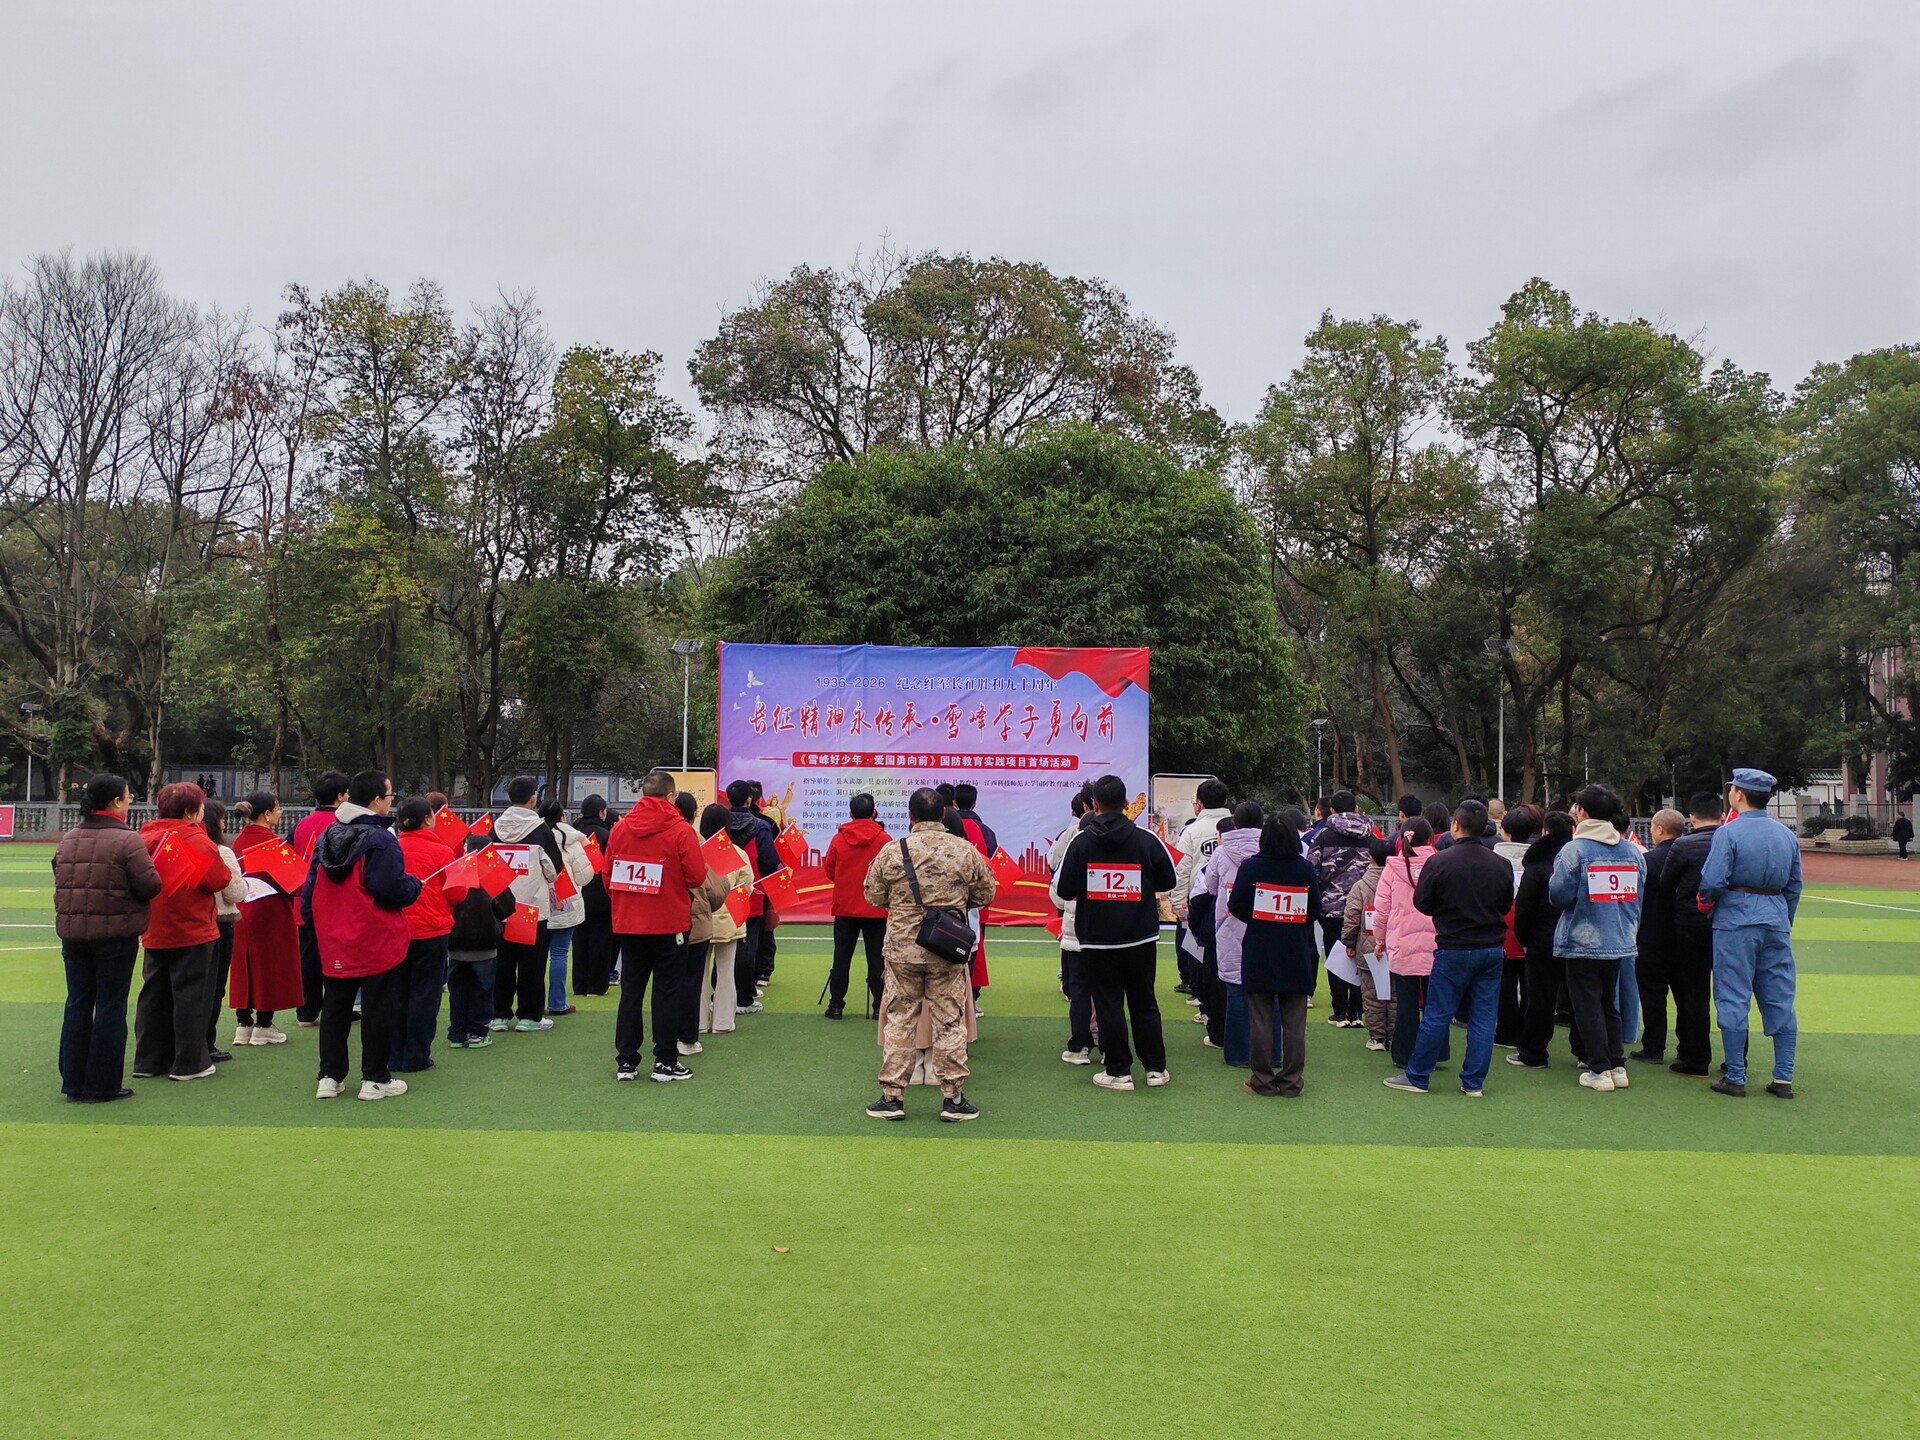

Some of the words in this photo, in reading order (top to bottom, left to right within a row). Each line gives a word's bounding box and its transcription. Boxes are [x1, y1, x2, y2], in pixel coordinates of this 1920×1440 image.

[896, 677, 1058, 691] 纪念红军长征胜利九十周年
[505, 852, 515, 867] 7
[627, 864, 647, 883] 14
[1102, 872, 1125, 890] 12
[1609, 874, 1619, 891] 9
[1272, 894, 1292, 912] 11
